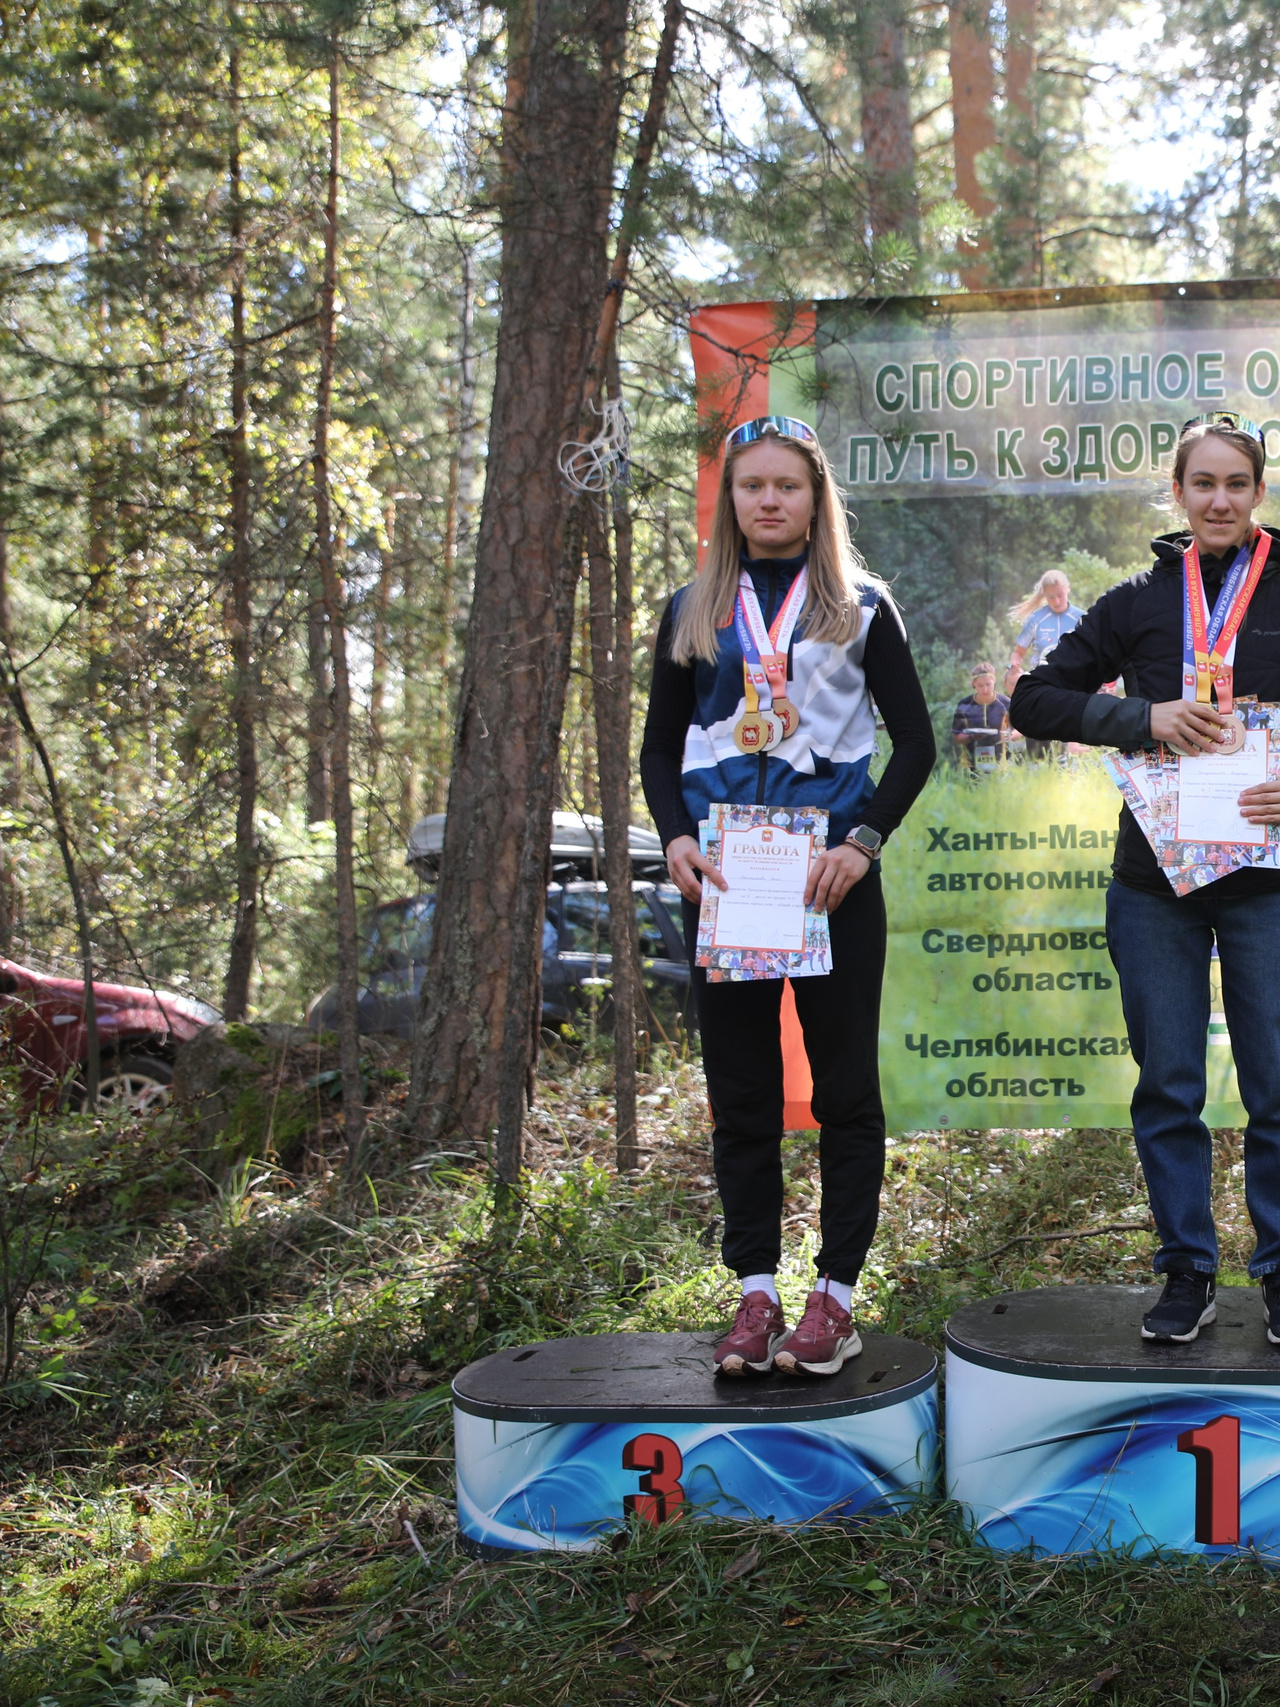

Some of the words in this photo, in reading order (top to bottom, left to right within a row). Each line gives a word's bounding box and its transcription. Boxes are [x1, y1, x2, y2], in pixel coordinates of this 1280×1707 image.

[875, 351, 1225, 413] СПОРТИВНОЕ
[848, 430, 977, 484] ПУТЬ
[996, 428, 1025, 479] К
[1191, 580, 1201, 638] ЧЕЛЯБИНСКАЯ
[1224, 608, 1242, 641] ОБЛАСТЬ
[732, 844, 800, 857] ГРАМОТА
[926, 824, 1119, 853] Ханты-Ман
[921, 928, 1107, 958] Свердловс
[972, 967, 1113, 993] область
[945, 1072, 1085, 1097] область
[622, 1432, 686, 1530] 3
[1177, 1414, 1241, 1546] 1
